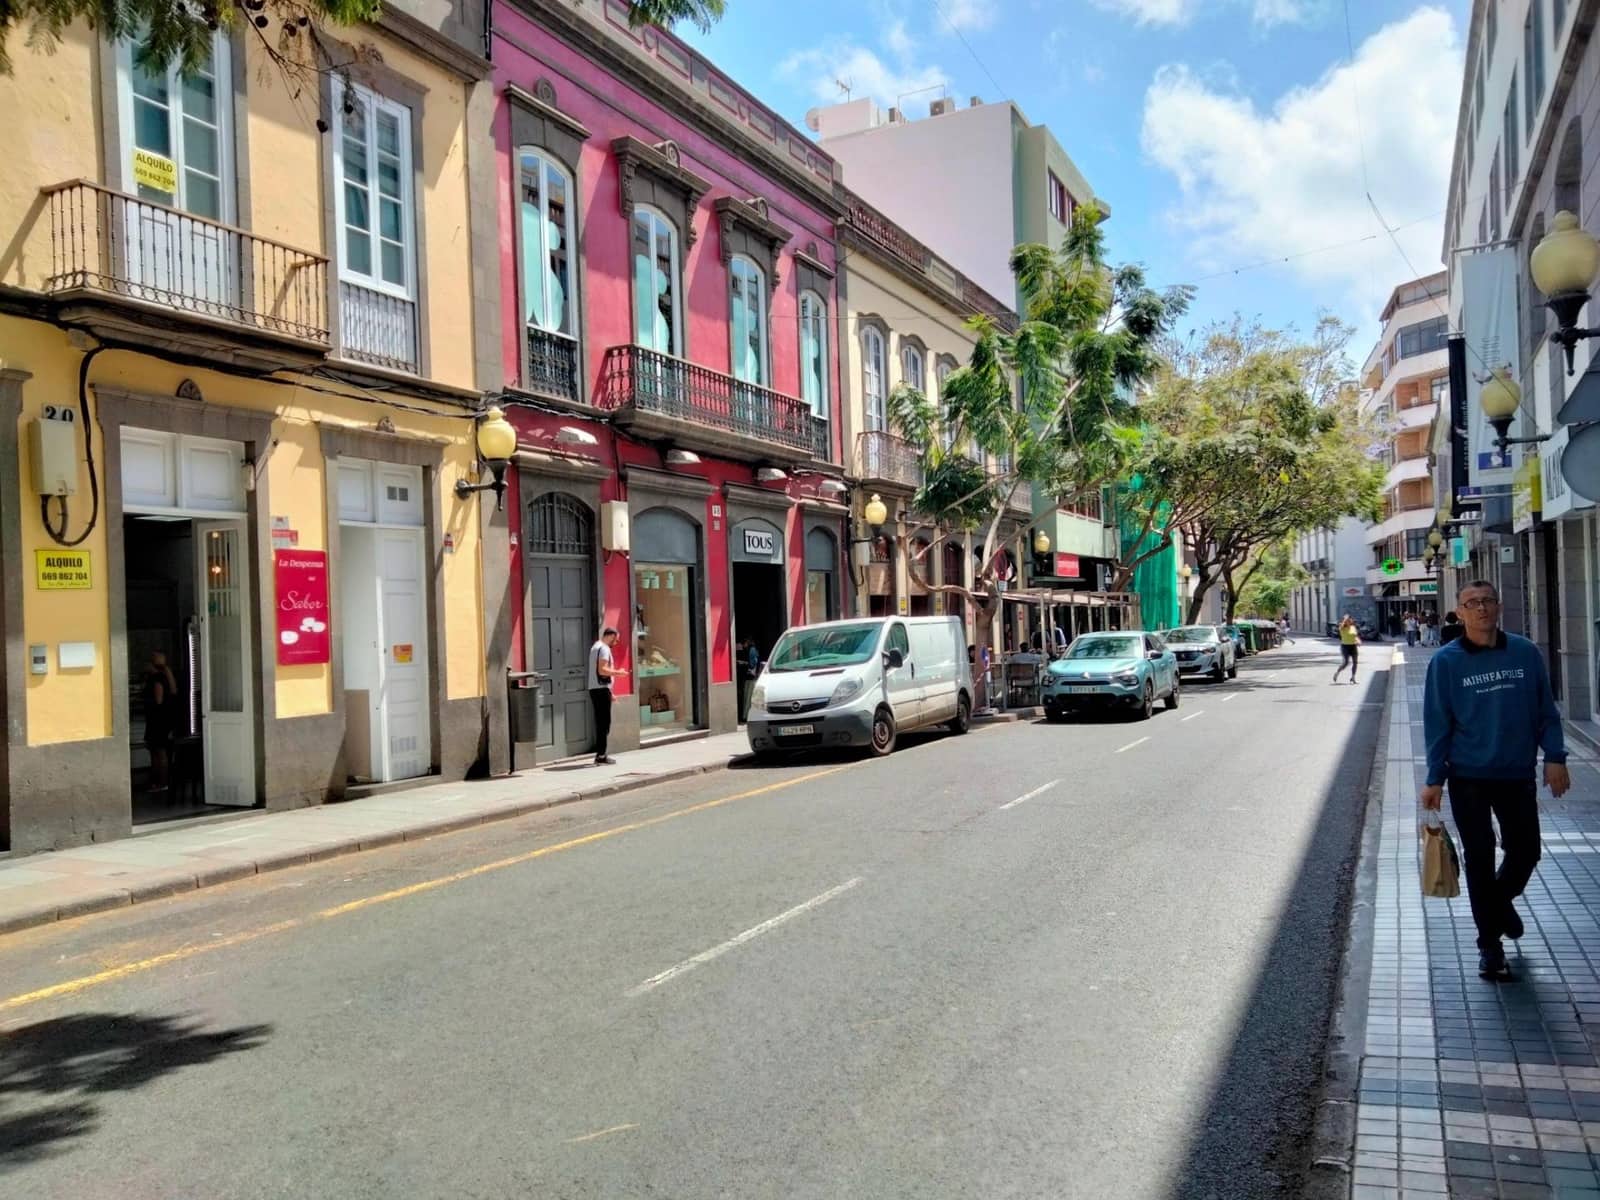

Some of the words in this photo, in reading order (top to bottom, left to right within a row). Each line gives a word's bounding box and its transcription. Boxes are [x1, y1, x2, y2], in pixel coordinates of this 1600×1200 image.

[136, 153, 172, 173] ALQUILO
[45, 406, 74, 422] 20
[747, 535, 773, 549] TOUS
[46, 557, 82, 568] ALQUILO
[280, 590, 324, 611] Sabor
[1463, 668, 1524, 687] MINNEAPOLIS
